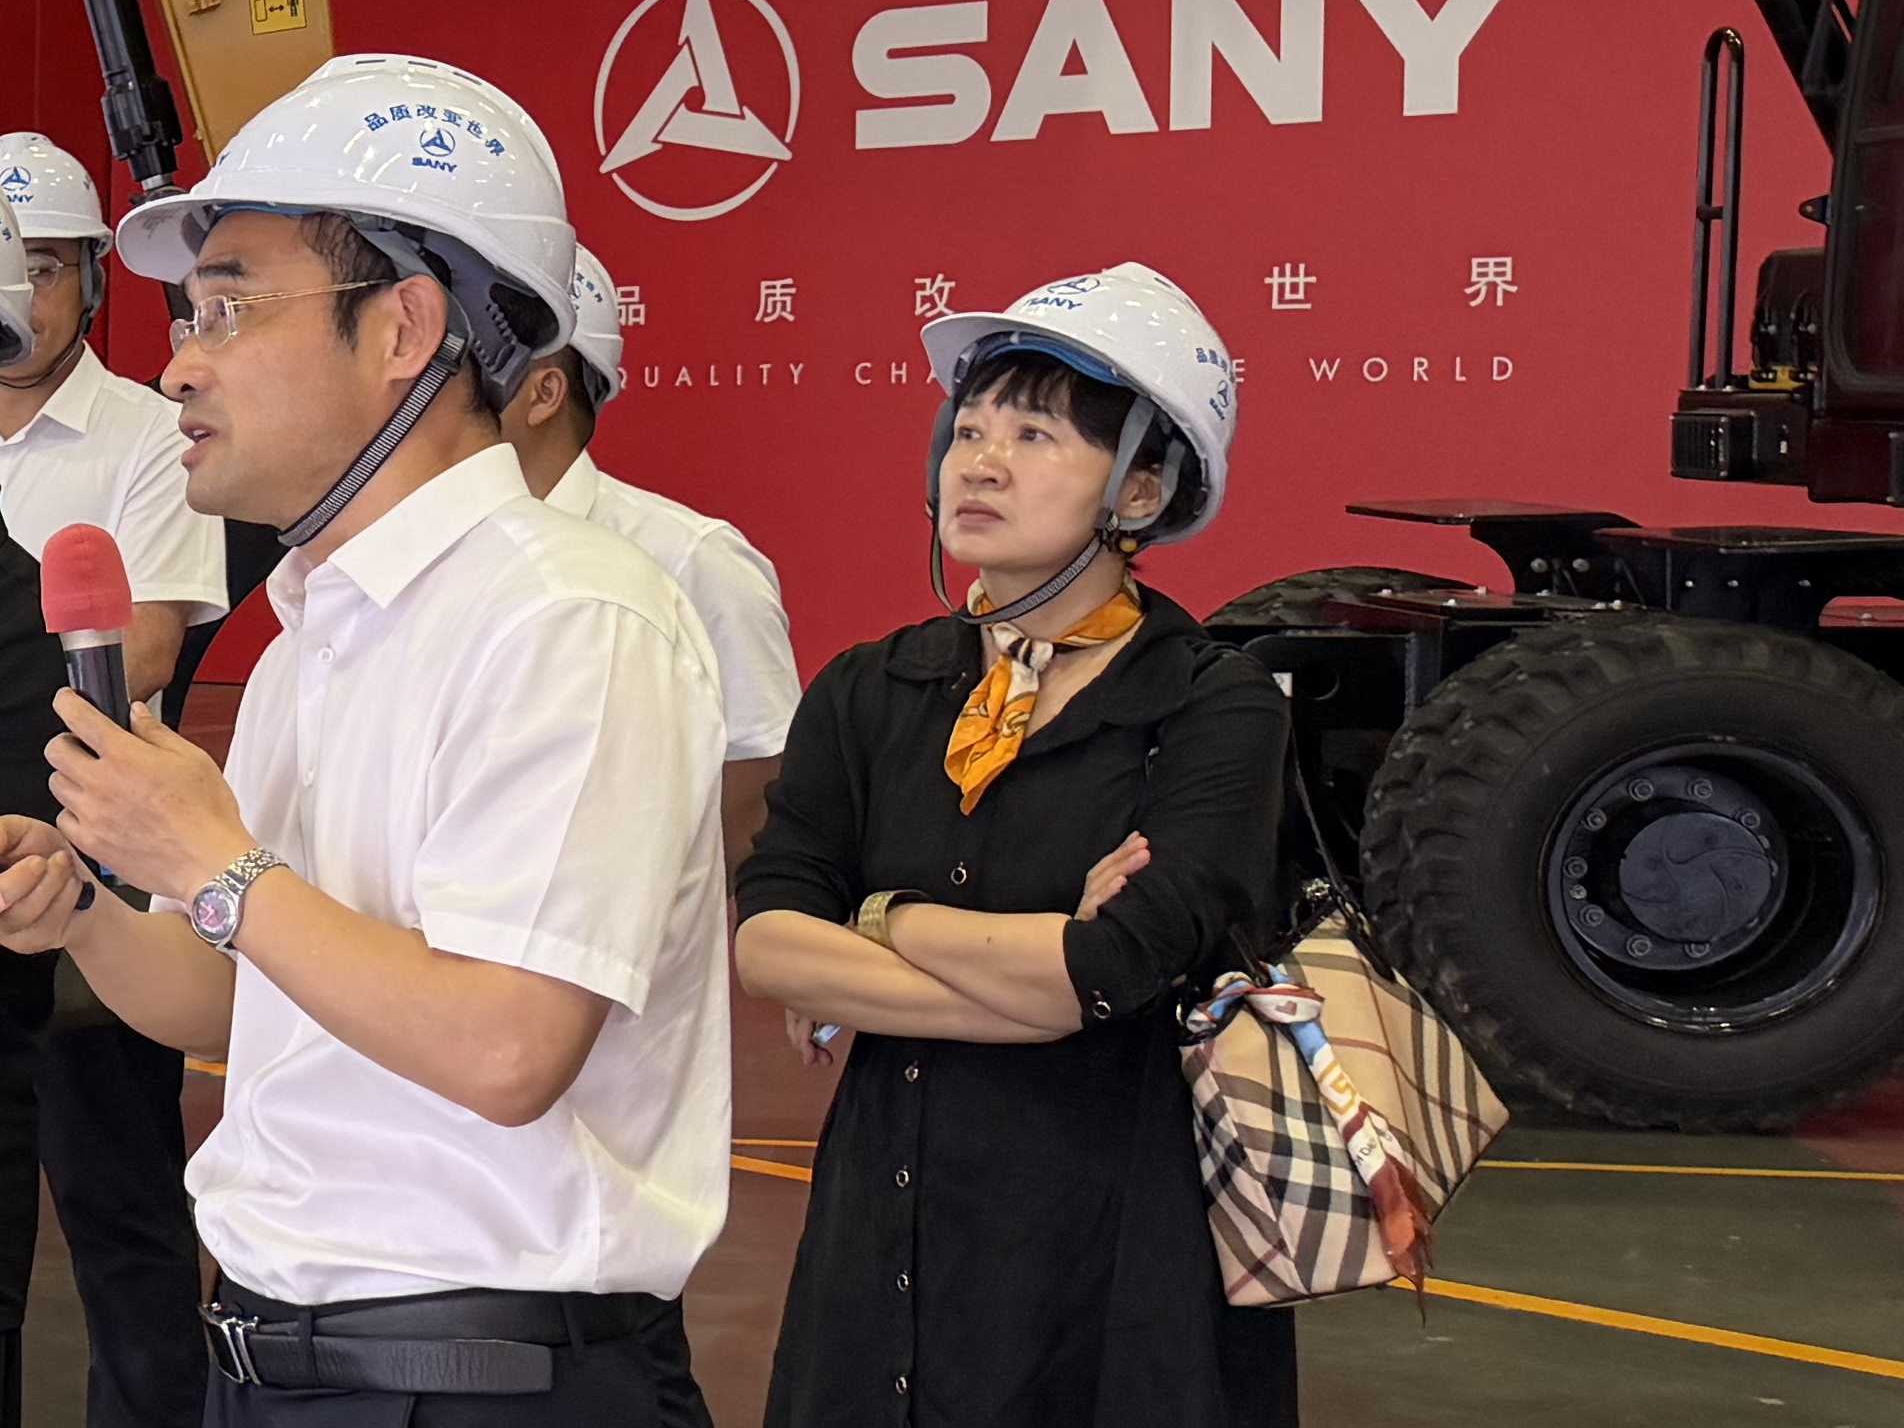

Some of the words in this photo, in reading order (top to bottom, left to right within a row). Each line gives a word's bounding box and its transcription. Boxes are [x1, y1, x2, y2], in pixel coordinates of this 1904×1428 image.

[412, 156, 458, 173] SANY
[6, 193, 34, 204] ANY
[1308, 356, 1513, 382] WORLD
